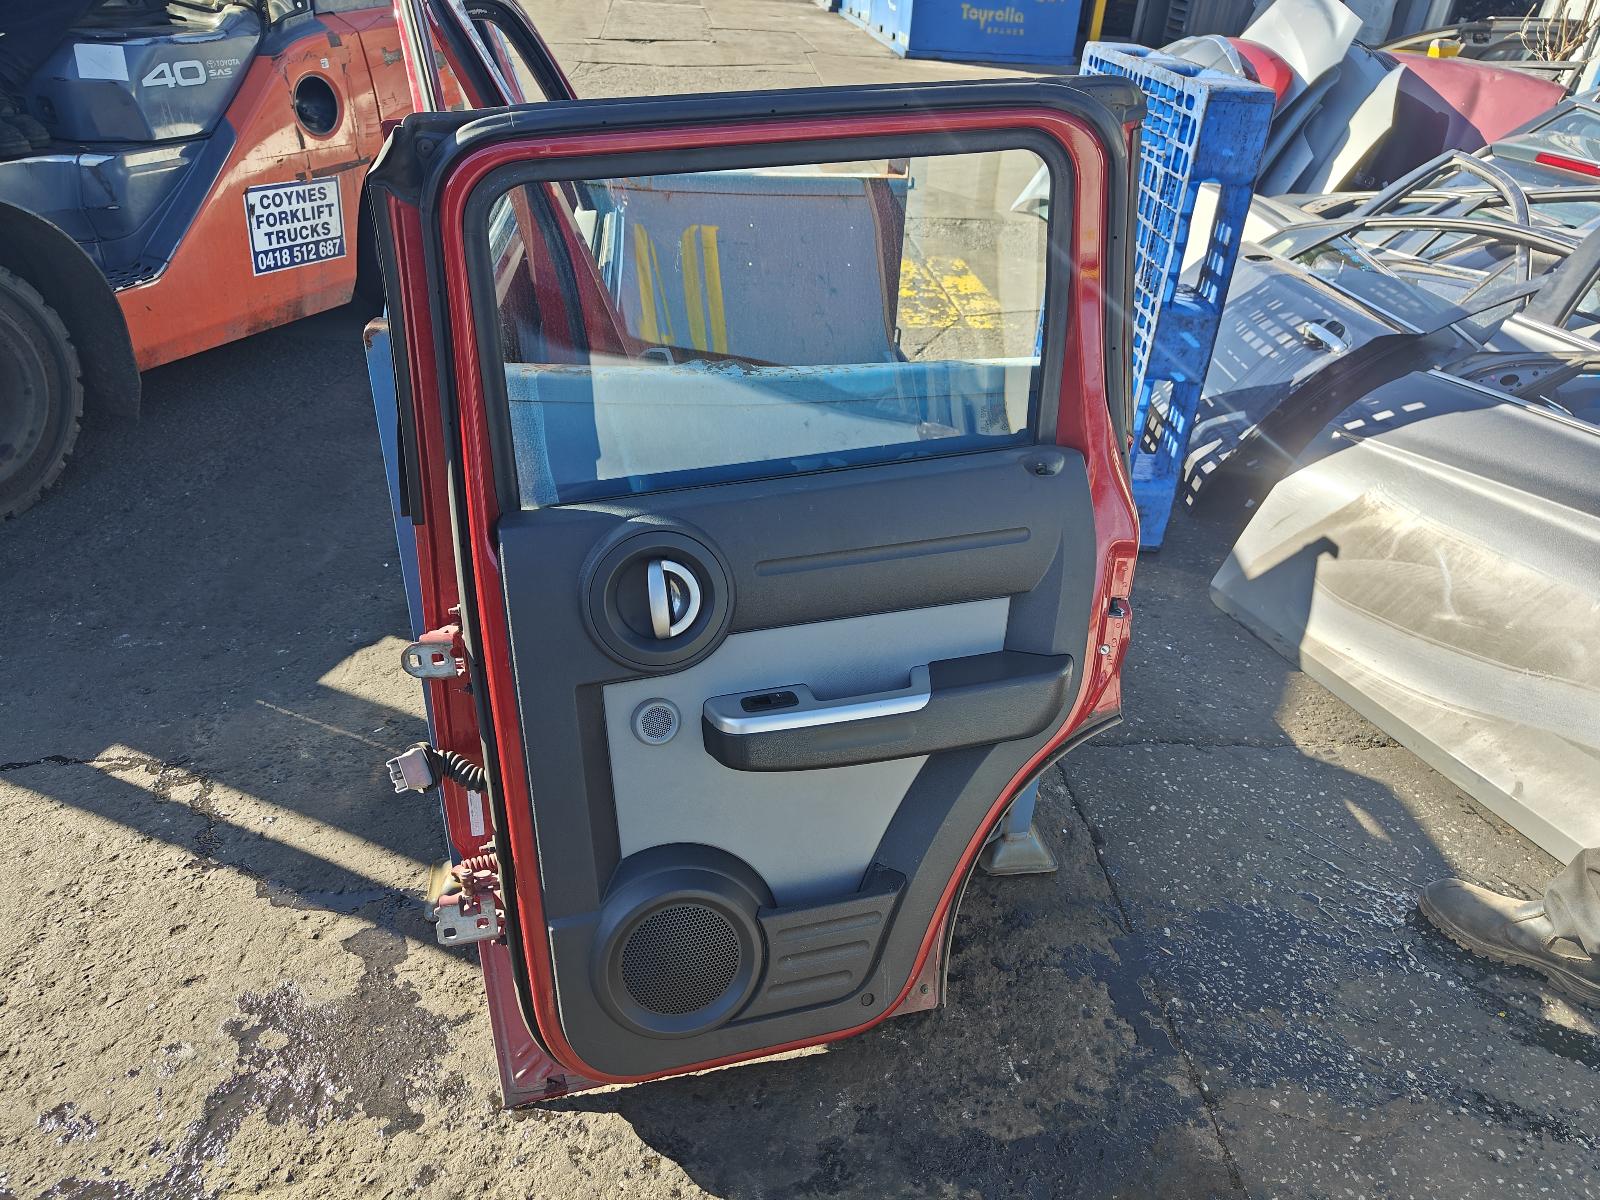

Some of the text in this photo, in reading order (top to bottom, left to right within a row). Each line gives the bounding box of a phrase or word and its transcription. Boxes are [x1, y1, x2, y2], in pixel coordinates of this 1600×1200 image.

[961, 3, 1024, 30] Toyrolla
[141, 60, 207, 88] 40
[208, 68, 232, 77] SAS
[216, 58, 240, 67] TOYOTA
[259, 186, 327, 210] COYNES
[255, 203, 335, 229] FORKLIFT
[264, 222, 331, 246] TRUCKS
[258, 239, 341, 270] 0418 512 687
